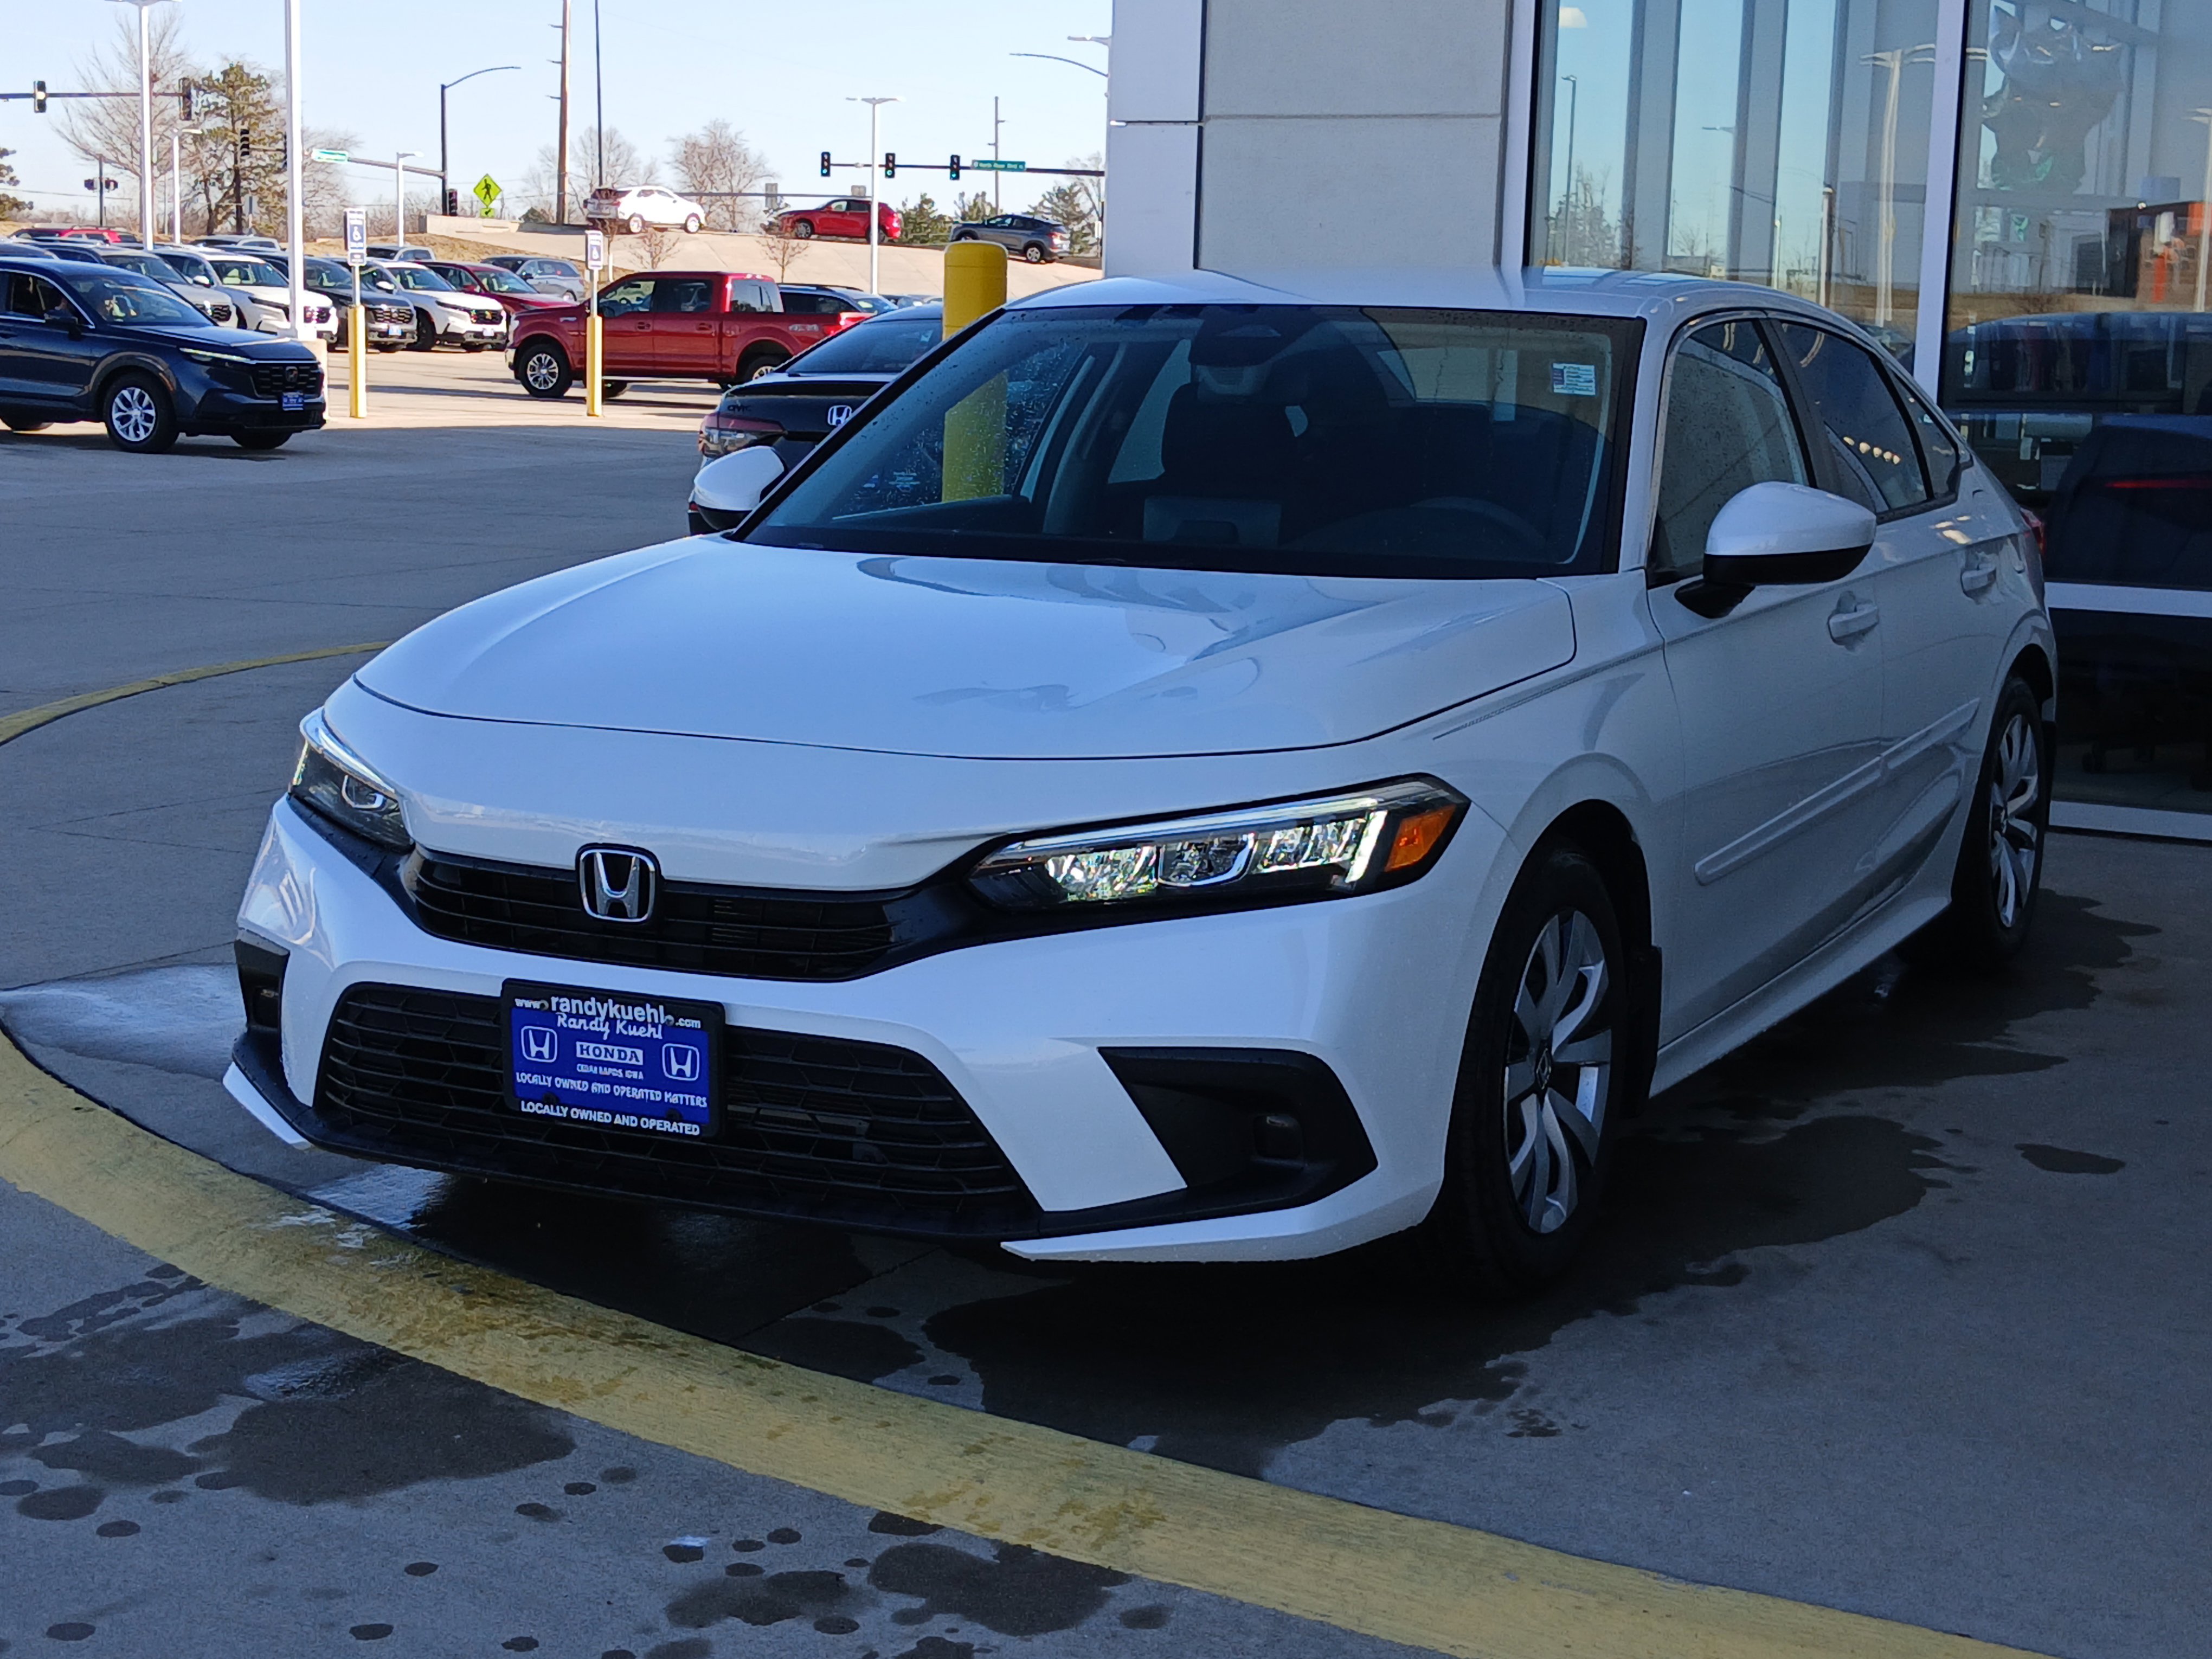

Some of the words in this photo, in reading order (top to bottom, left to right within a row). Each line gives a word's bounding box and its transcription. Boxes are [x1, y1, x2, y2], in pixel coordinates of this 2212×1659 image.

[555, 1012, 610, 1040] Randy
[616, 1019, 663, 1039] Kuehl
[579, 1044, 640, 1063] HONDA
[516, 1072, 552, 1088] LOCALLY
[555, 1077, 589, 1091] OWNED
[591, 1082, 611, 1094] AND
[613, 1085, 662, 1102] OPERATED
[664, 1091, 708, 1108] MATTERS
[521, 1101, 569, 1117] LOCALLY
[570, 1108, 612, 1123] OWNED
[613, 1114, 638, 1127] AND
[640, 1117, 700, 1136] OPERATED
